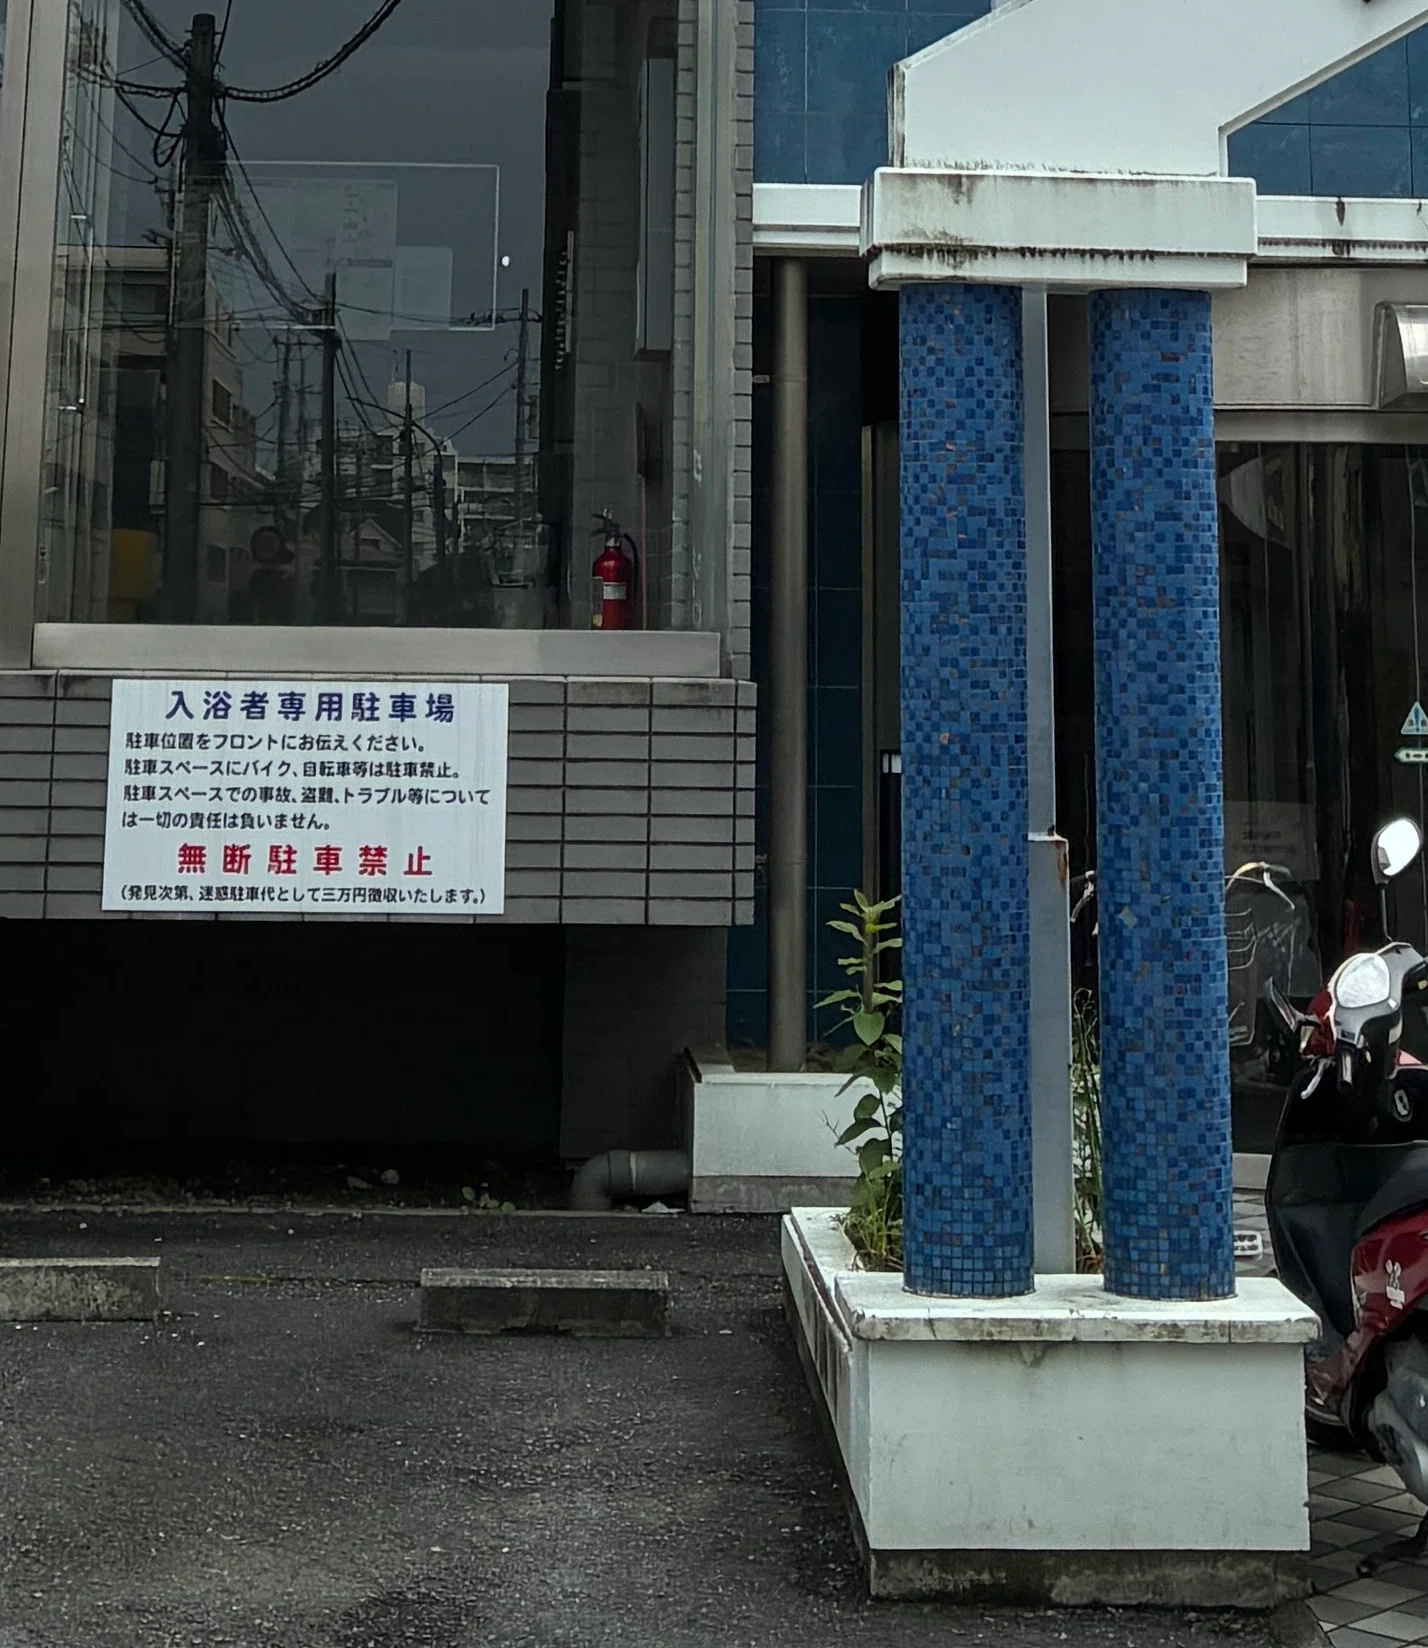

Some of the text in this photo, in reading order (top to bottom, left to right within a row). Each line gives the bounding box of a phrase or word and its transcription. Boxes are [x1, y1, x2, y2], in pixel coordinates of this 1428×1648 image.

[165, 690, 455, 723] 入浴者専用駐車場
[125, 732, 424, 752] 駐車位置をフロントにお伝えください。
[124, 759, 459, 778] 駐車スペースにバイク、自転車等は駐車禁止。
[122, 811, 330, 830] は一切の責任は負いません。
[178, 843, 433, 876] 無断駐車禁止
